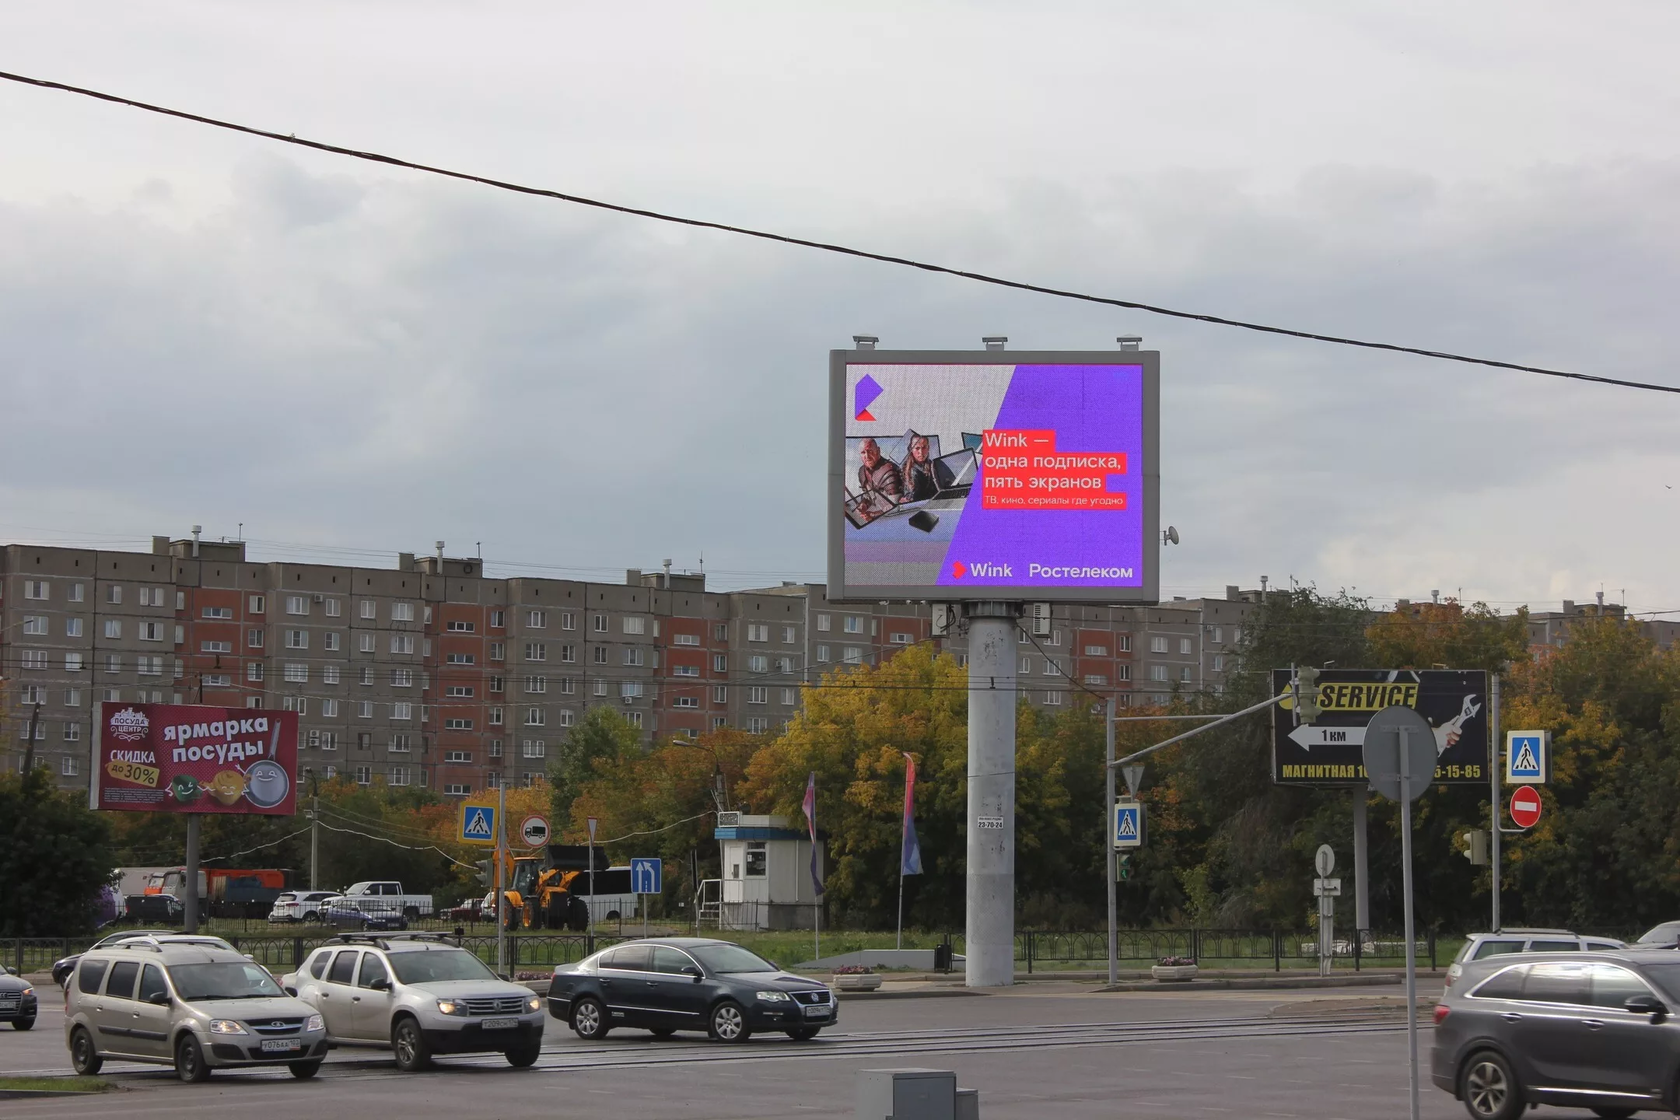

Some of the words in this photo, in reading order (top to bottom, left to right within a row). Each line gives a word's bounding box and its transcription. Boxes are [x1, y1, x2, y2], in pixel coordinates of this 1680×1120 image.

[984, 432, 1028, 447] Wink
[984, 456, 1028, 470] одна
[1033, 456, 1121, 470] подписка,
[984, 476, 1024, 489] пять
[1028, 476, 1102, 492] экранов
[1027, 497, 1069, 506] сериалы
[1071, 496, 1088, 506] где
[1089, 496, 1124, 506] угодно
[970, 561, 1013, 578] Wink
[1028, 562, 1133, 579] Ростелеком
[1319, 684, 1417, 708] SERVICE
[114, 717, 146, 726] ПОСУДА
[117, 725, 142, 733] ЦЕНТР
[163, 716, 269, 746] ярмарка
[1321, 729, 1327, 742] 1
[110, 749, 156, 764] СКИДКА
[172, 740, 264, 765] посуды
[111, 763, 124, 774] до
[124, 763, 155, 785] 30%
[1282, 764, 1355, 779] МАГНИТНАЯ
